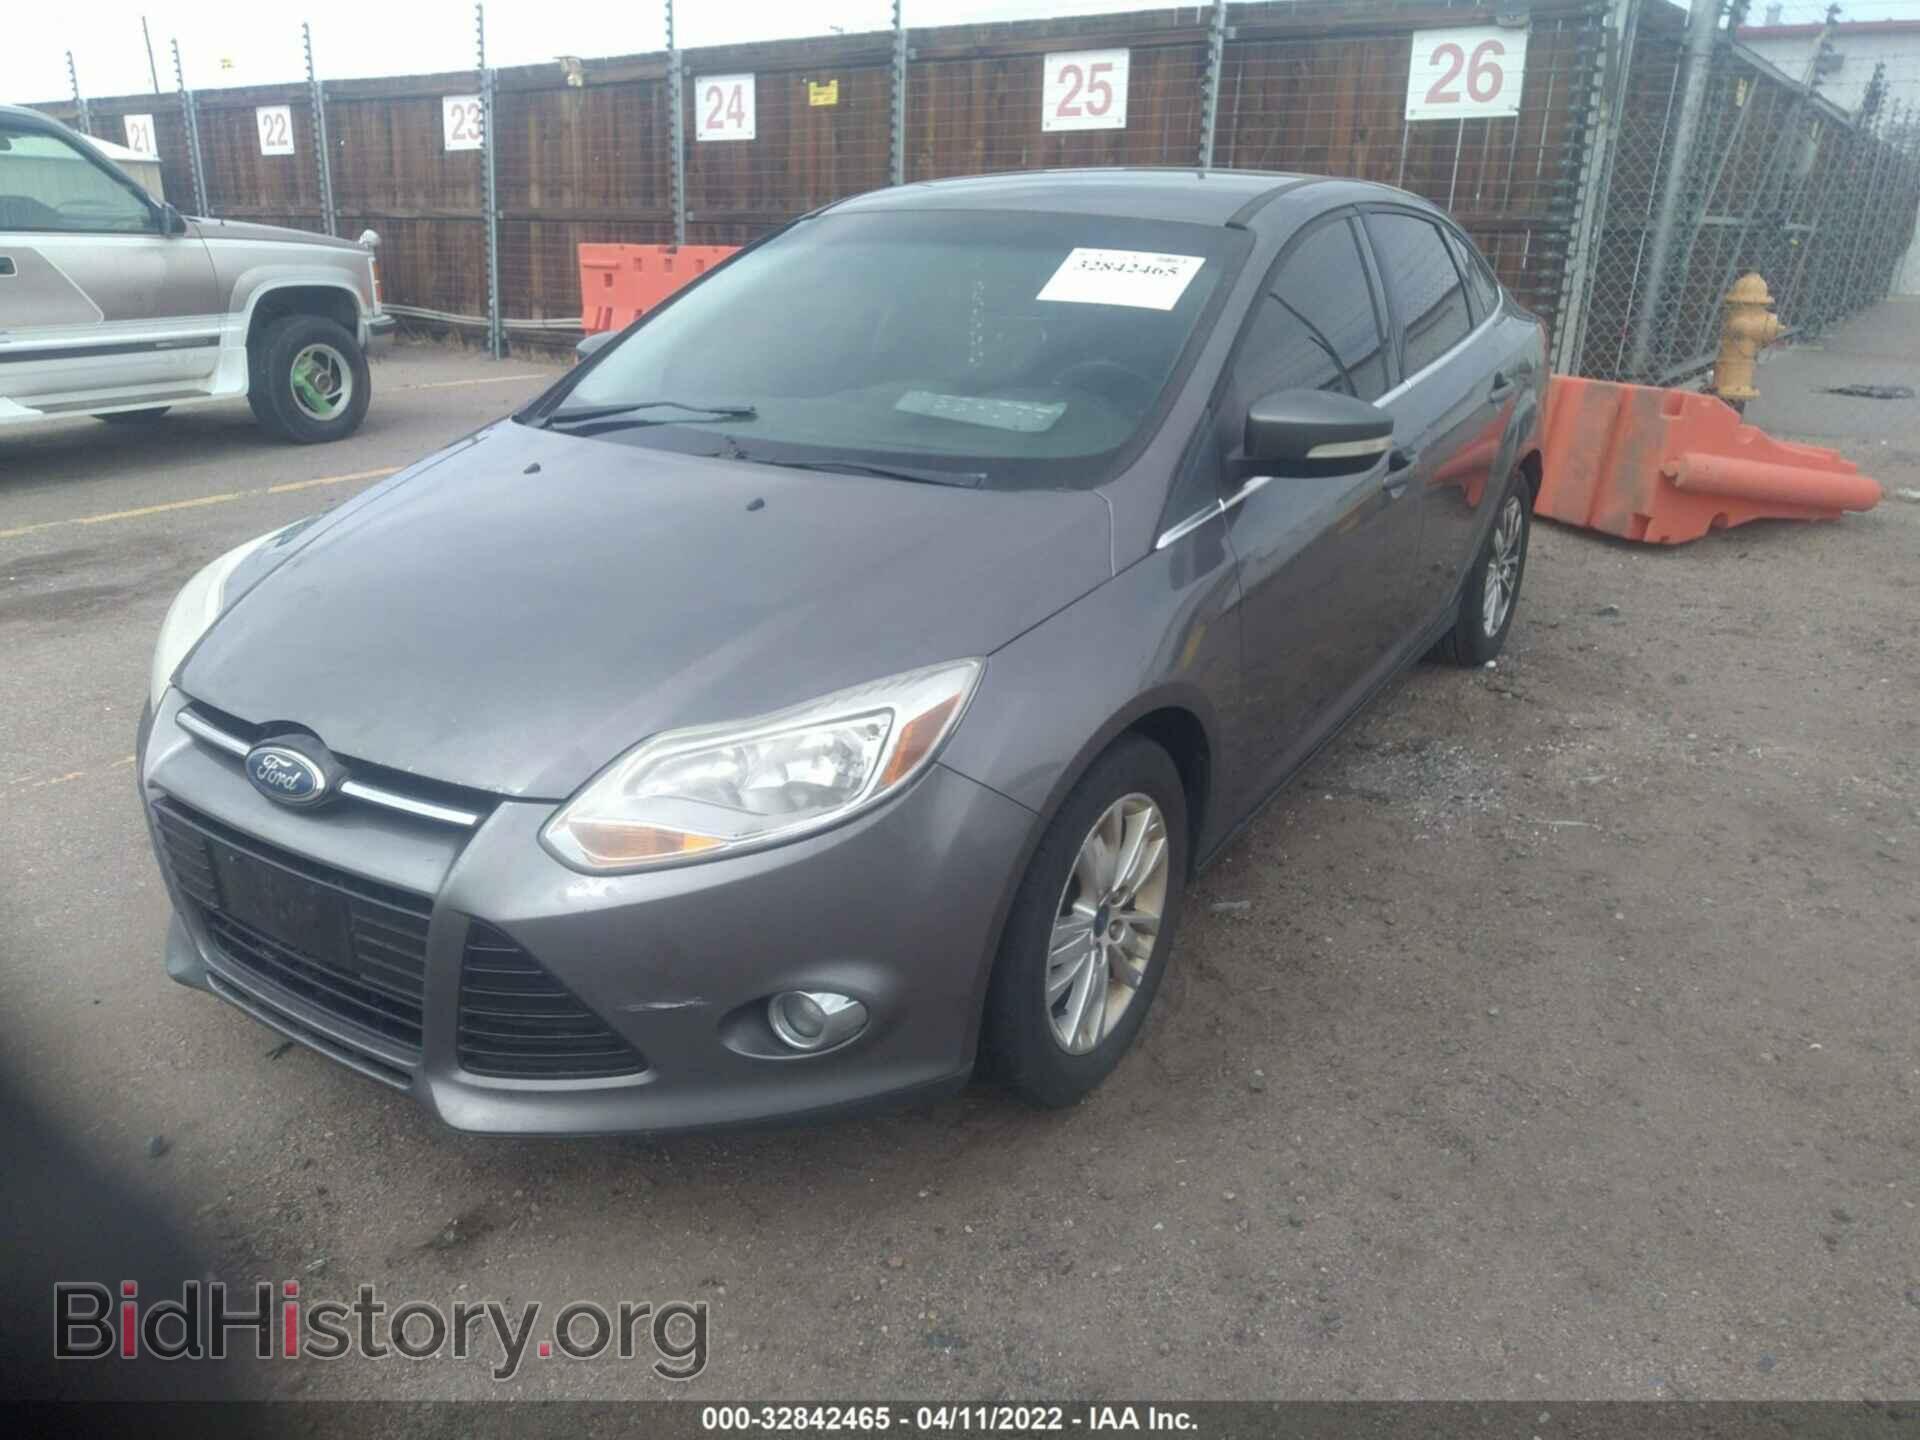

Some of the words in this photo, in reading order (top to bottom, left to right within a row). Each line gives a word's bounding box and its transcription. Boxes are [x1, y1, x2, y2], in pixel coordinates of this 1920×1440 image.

[1056, 62, 1113, 117] 25
[1424, 39, 1505, 104] 26
[450, 102, 481, 141] 23
[704, 83, 746, 130] 24
[130, 121, 151, 153] 21
[262, 112, 289, 147] 22
[256, 754, 302, 792] Ford
